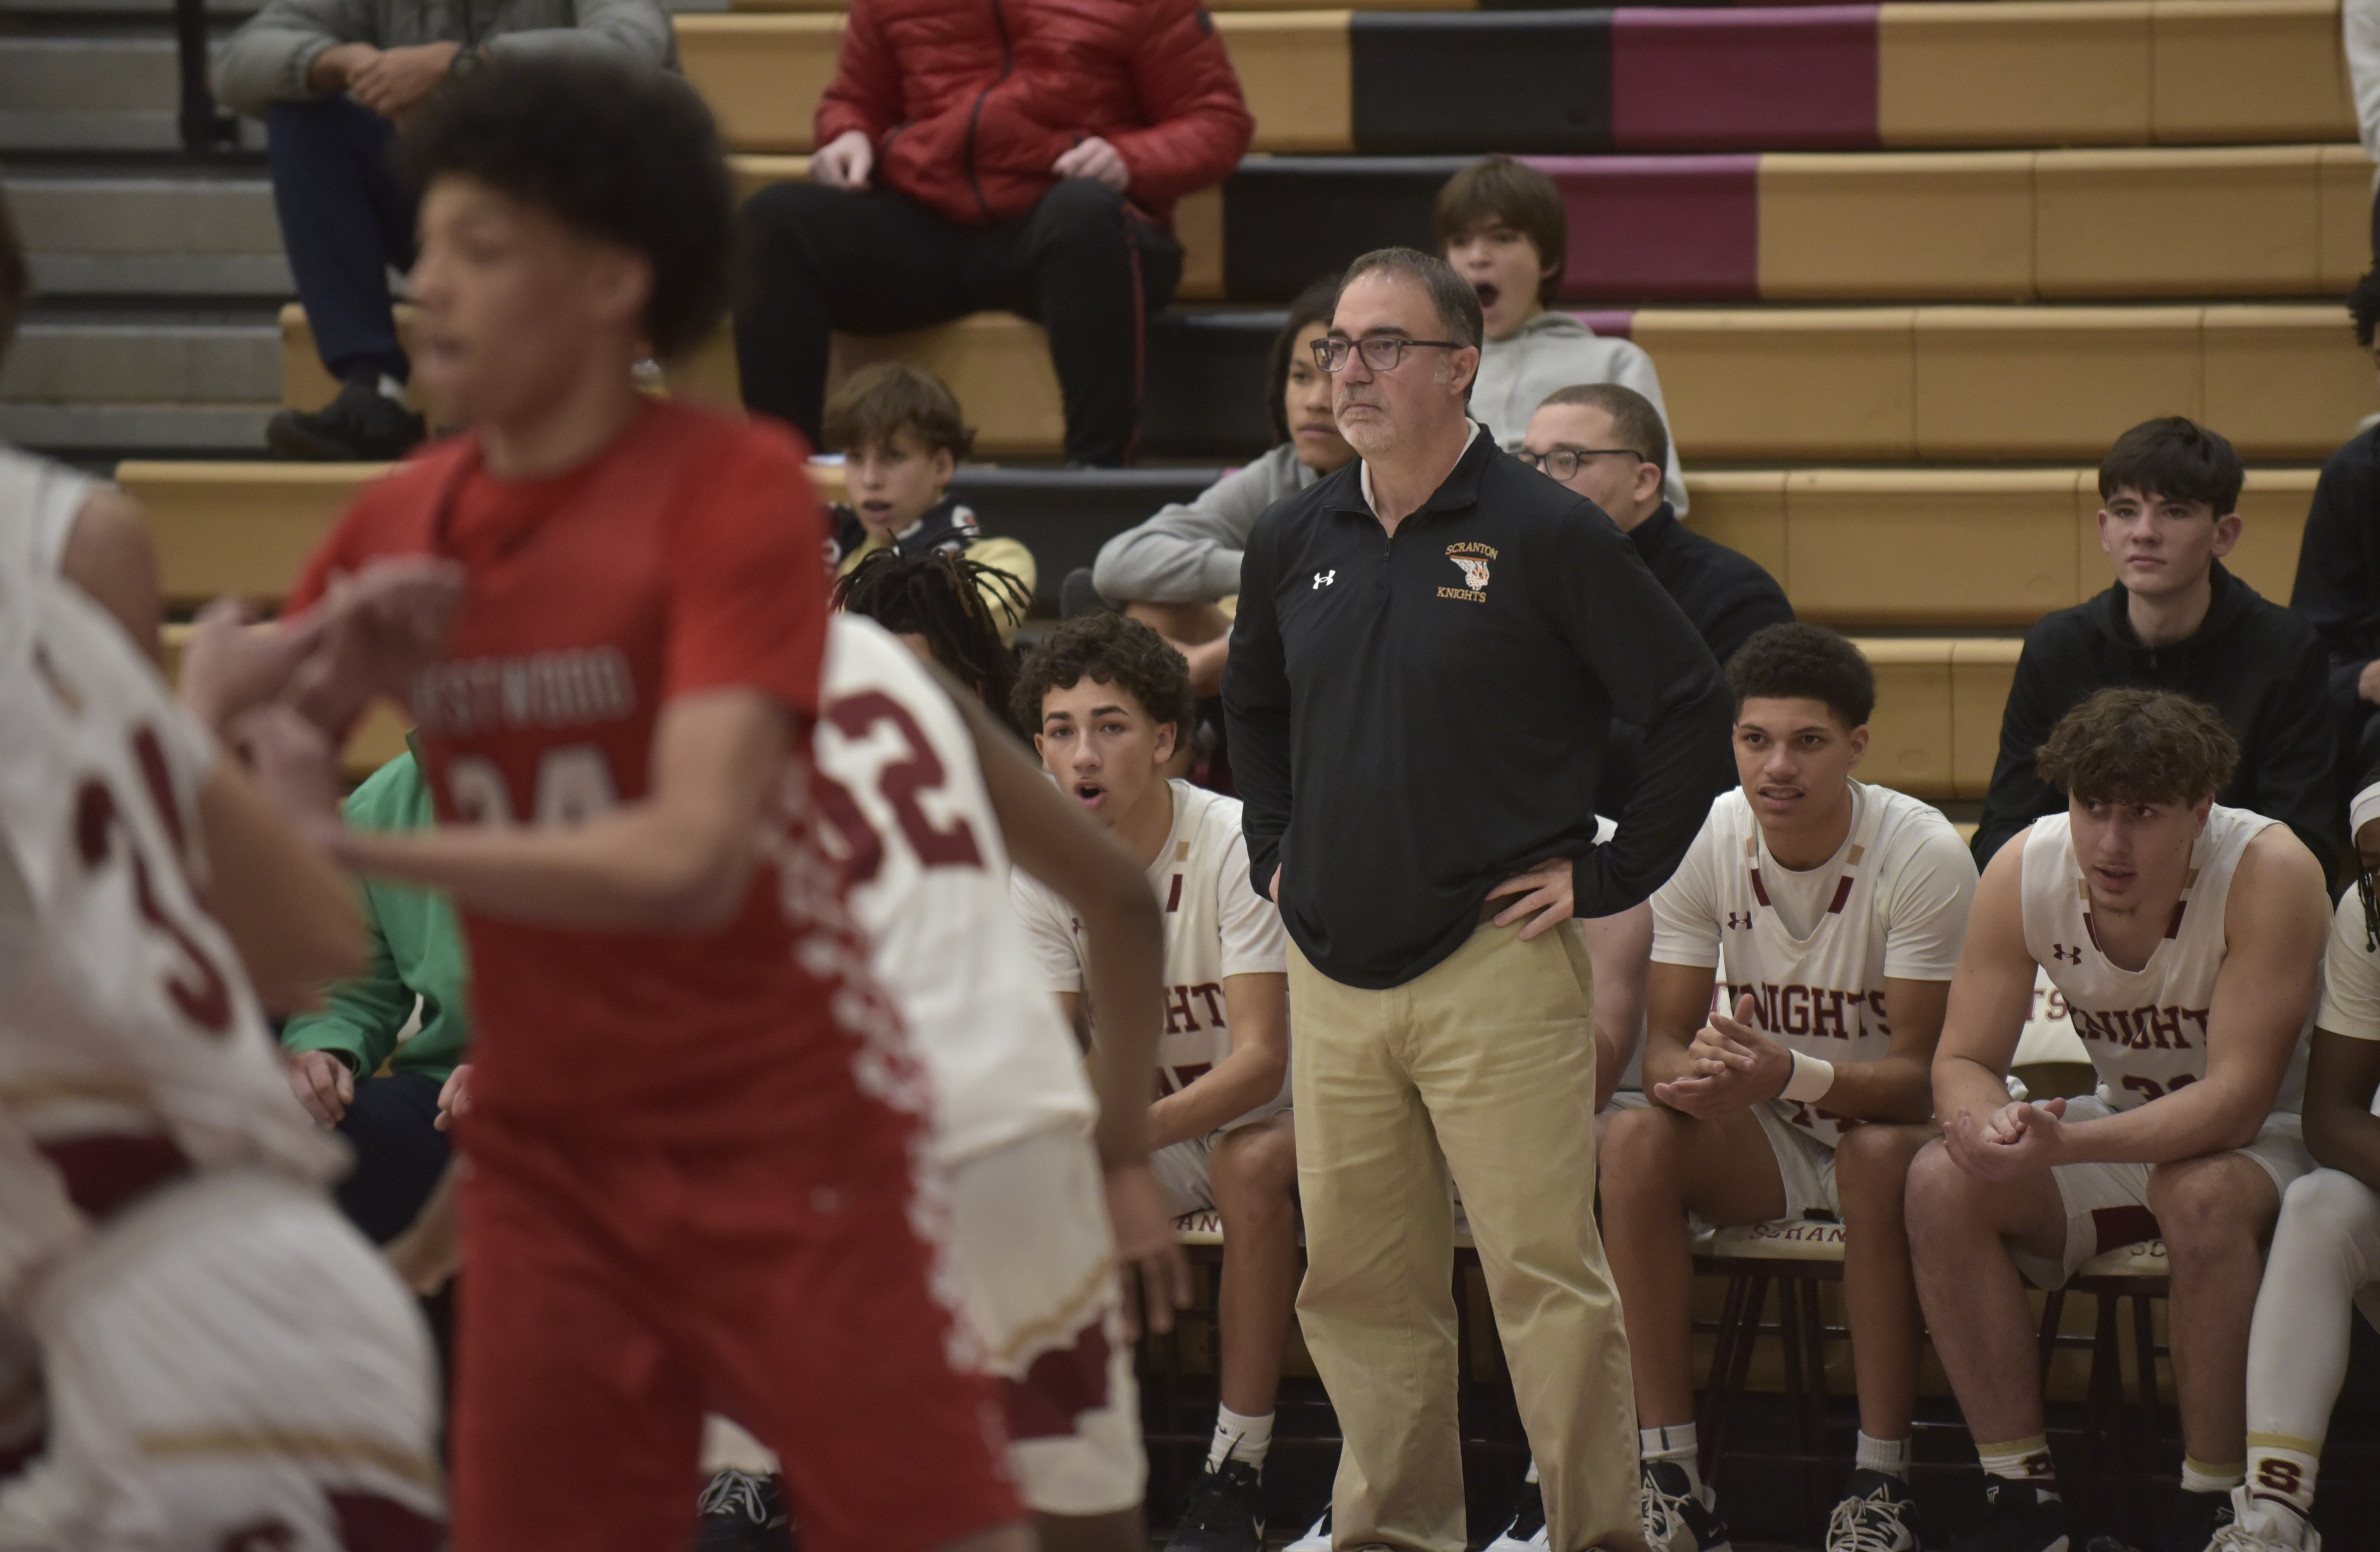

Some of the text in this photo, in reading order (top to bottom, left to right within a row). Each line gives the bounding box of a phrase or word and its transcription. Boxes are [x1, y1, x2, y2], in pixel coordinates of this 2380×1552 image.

[1445, 542, 1498, 560] SCRANTON
[1437, 586, 1487, 603] KNIGHTS
[2257, 1457, 2303, 1498] S
